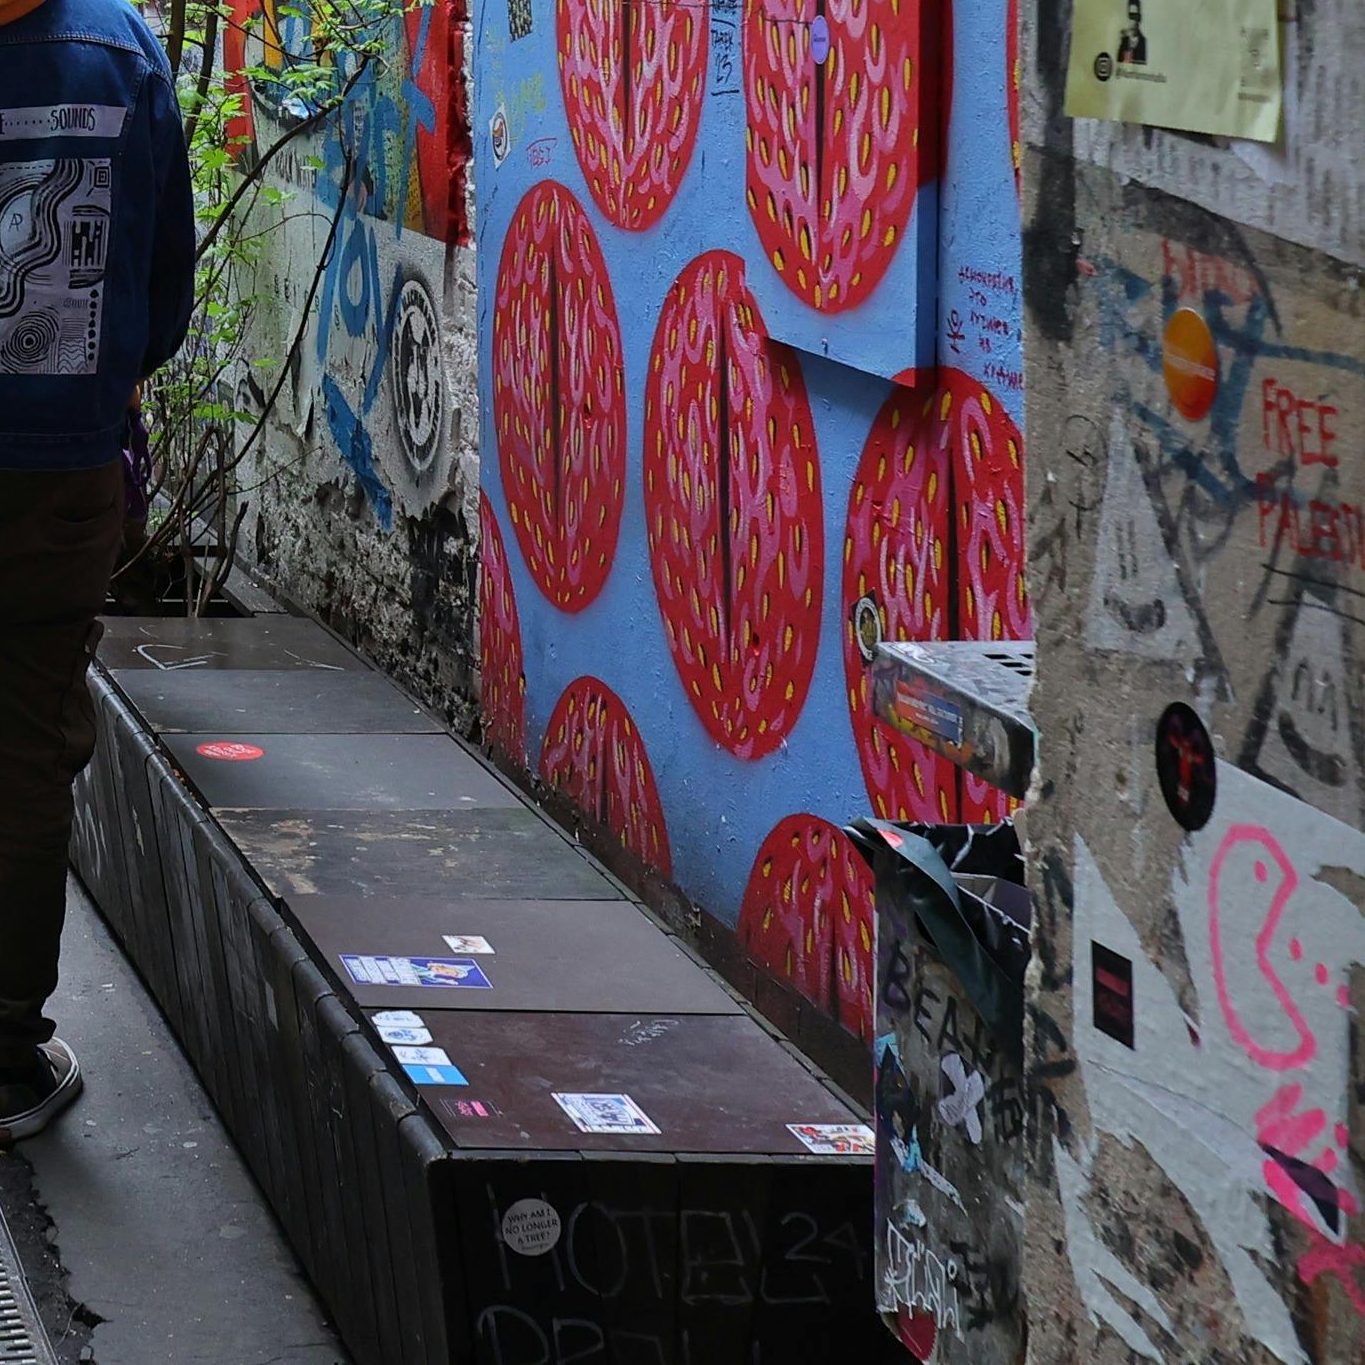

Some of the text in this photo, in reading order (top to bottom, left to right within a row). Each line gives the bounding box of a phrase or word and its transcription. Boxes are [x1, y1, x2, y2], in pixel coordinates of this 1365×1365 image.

[50, 108, 95, 131] SOUNDS
[1262, 378, 1340, 467] FREE
[508, 1212, 528, 1223] WHY
[530, 1209, 545, 1219] AM
[505, 1218, 558, 1235] NO LONGER
